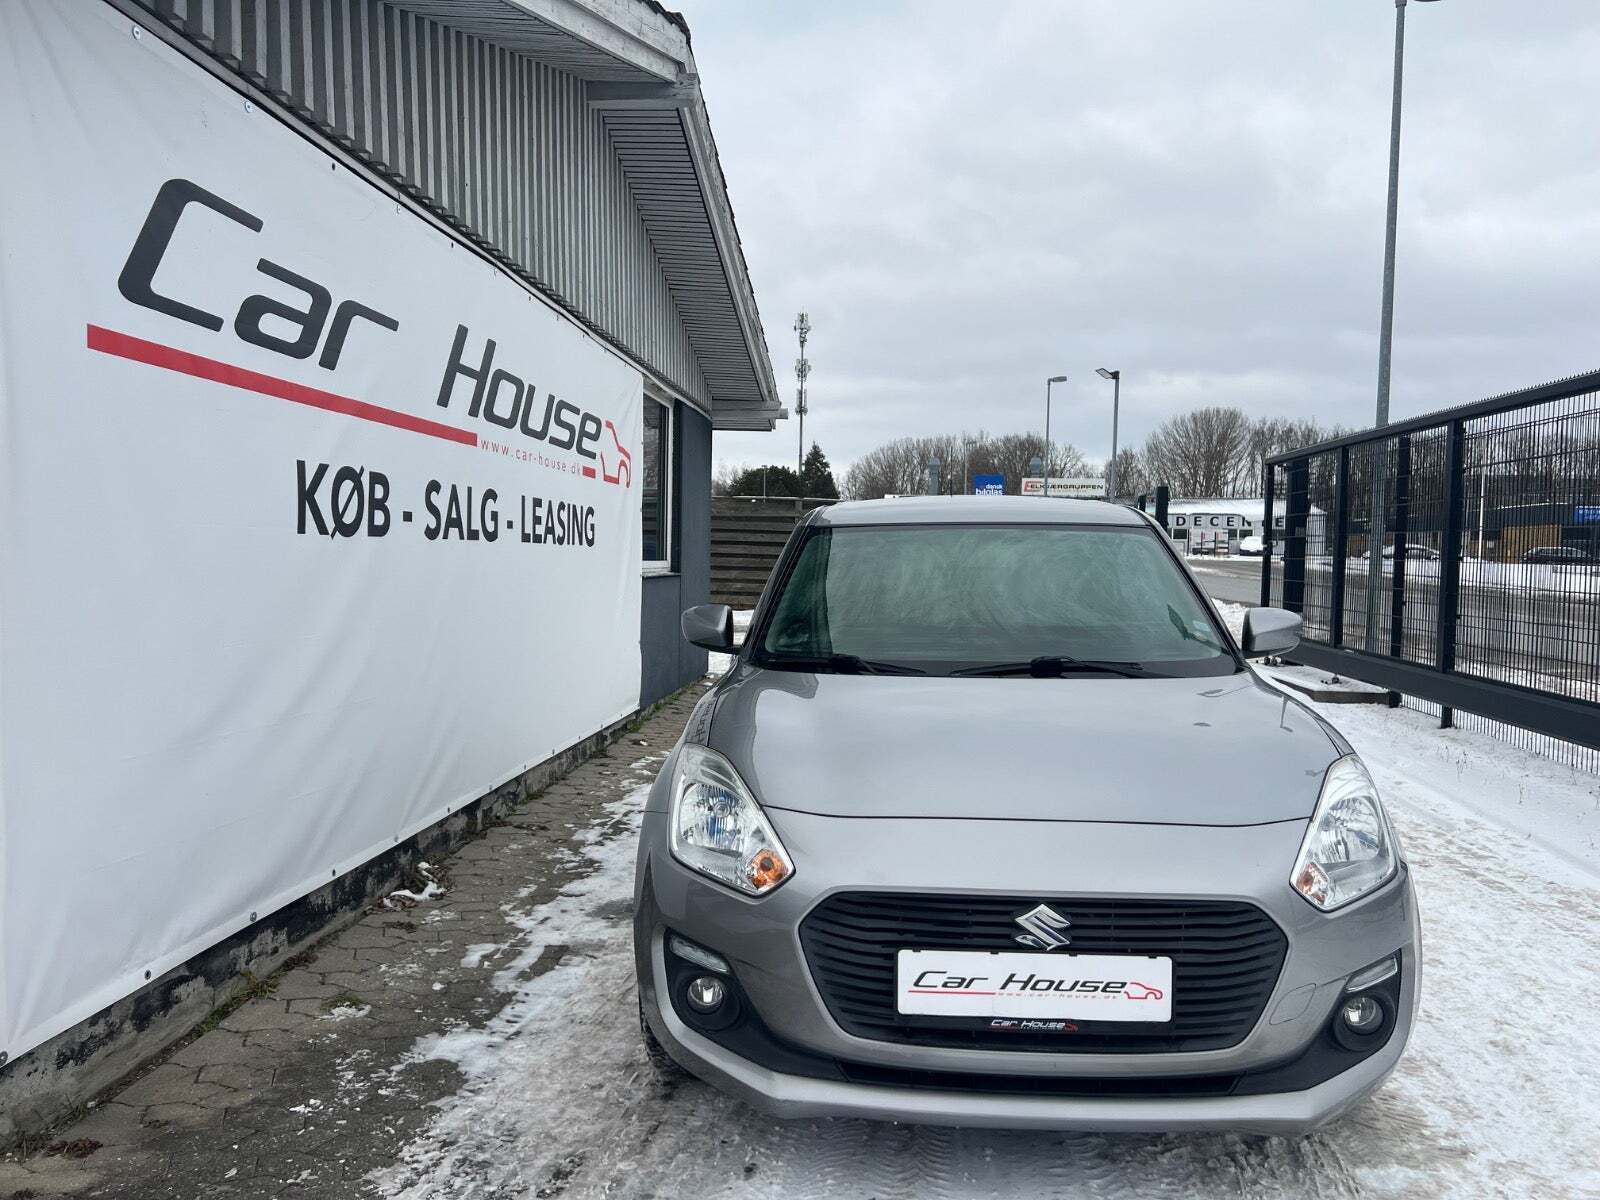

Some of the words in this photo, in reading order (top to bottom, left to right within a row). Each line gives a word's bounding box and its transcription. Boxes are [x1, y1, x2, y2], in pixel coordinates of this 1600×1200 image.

[117, 179, 398, 371] Car
[436, 324, 602, 460] House
[480, 439, 581, 475] www.car-house.dk
[296, 459, 391, 540] KØB
[423, 479, 499, 543] SALG
[520, 495, 595, 547] LEASING
[913, 970, 989, 989] Car
[999, 973, 1128, 994] House
[1020, 1020, 1066, 1029] House
